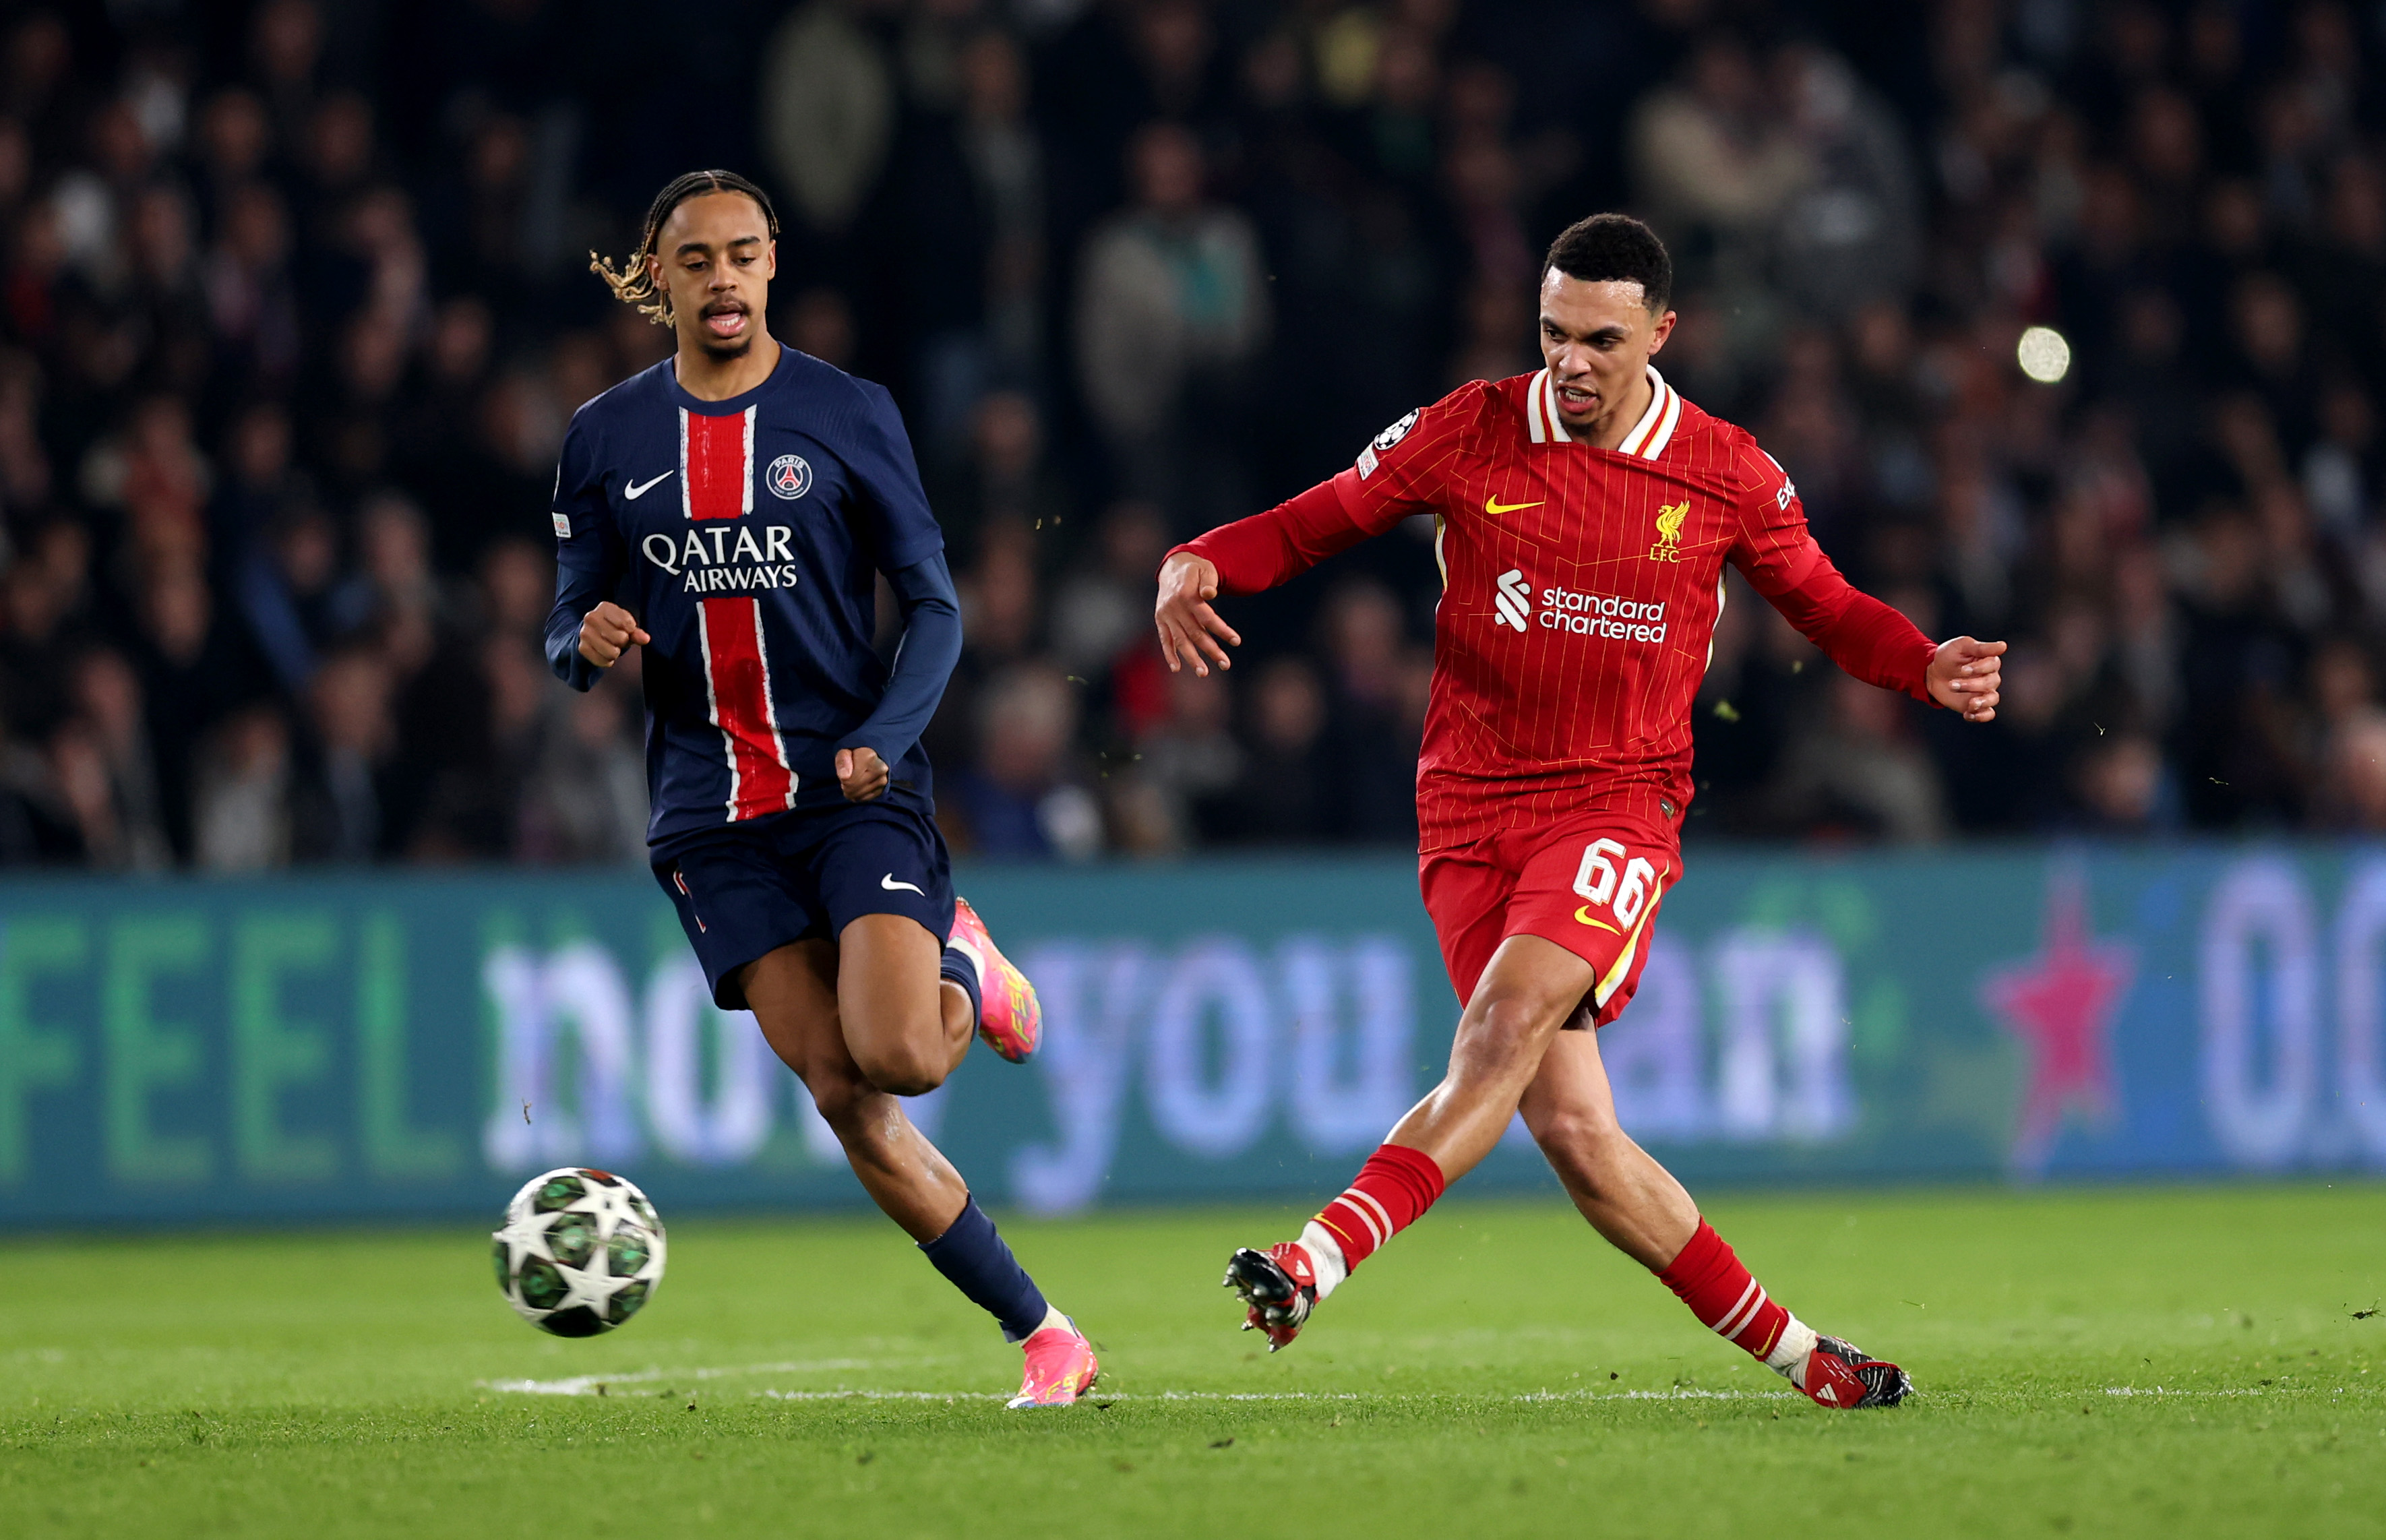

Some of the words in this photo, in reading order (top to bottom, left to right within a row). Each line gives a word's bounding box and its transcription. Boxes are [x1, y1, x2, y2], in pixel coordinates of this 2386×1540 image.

[774, 457, 805, 468] PARIS
[642, 526, 795, 576] QATAR
[683, 565, 797, 592] AIRWAYS
[1541, 586, 1665, 621] standard
[1539, 609, 1667, 643] chartered
[1572, 837, 1656, 932] 66
[1000, 964, 1031, 1045] F50
[0, 911, 465, 1176] FEEL
[1008, 933, 1417, 1210] you
